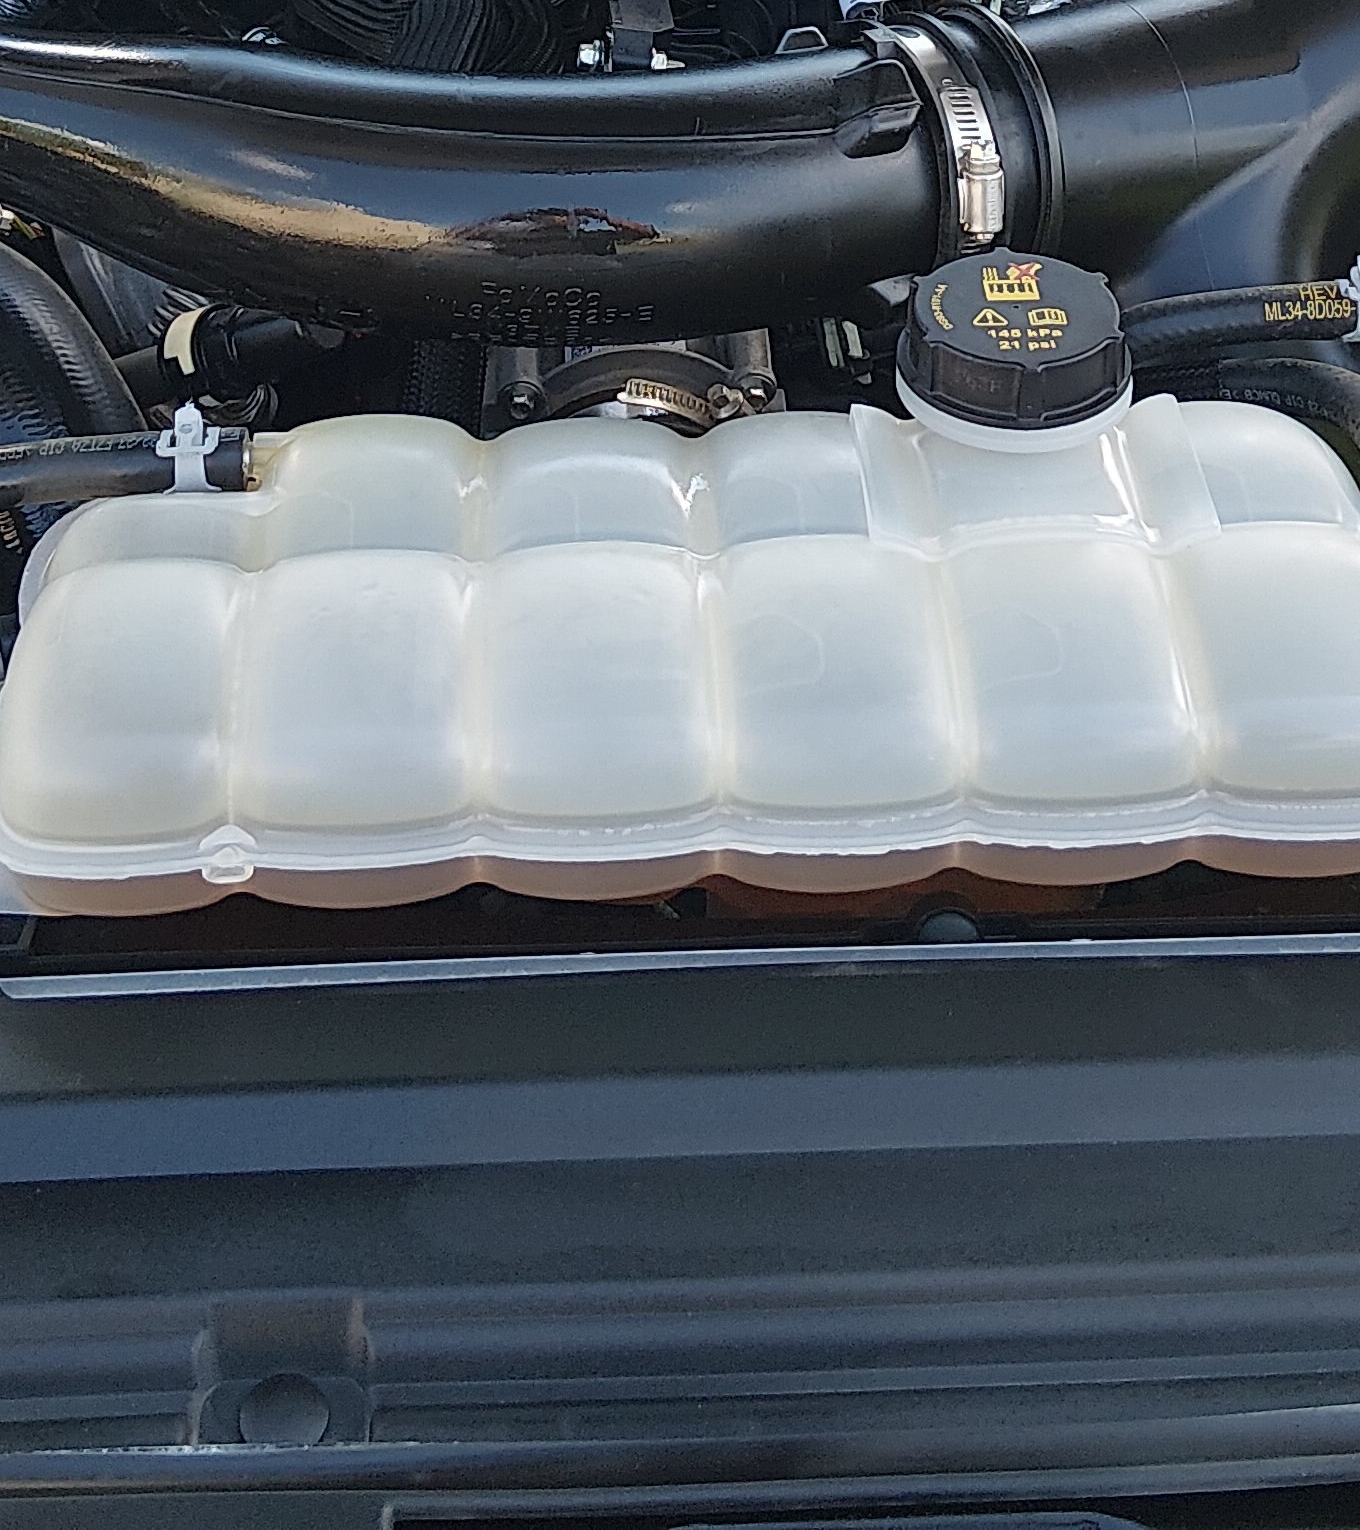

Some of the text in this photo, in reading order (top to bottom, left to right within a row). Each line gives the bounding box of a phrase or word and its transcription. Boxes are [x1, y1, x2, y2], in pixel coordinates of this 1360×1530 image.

[1298, 285, 1338, 301] HEV
[1026, 327, 1063, 339] kPa
[998, 340, 1020, 350] 21
